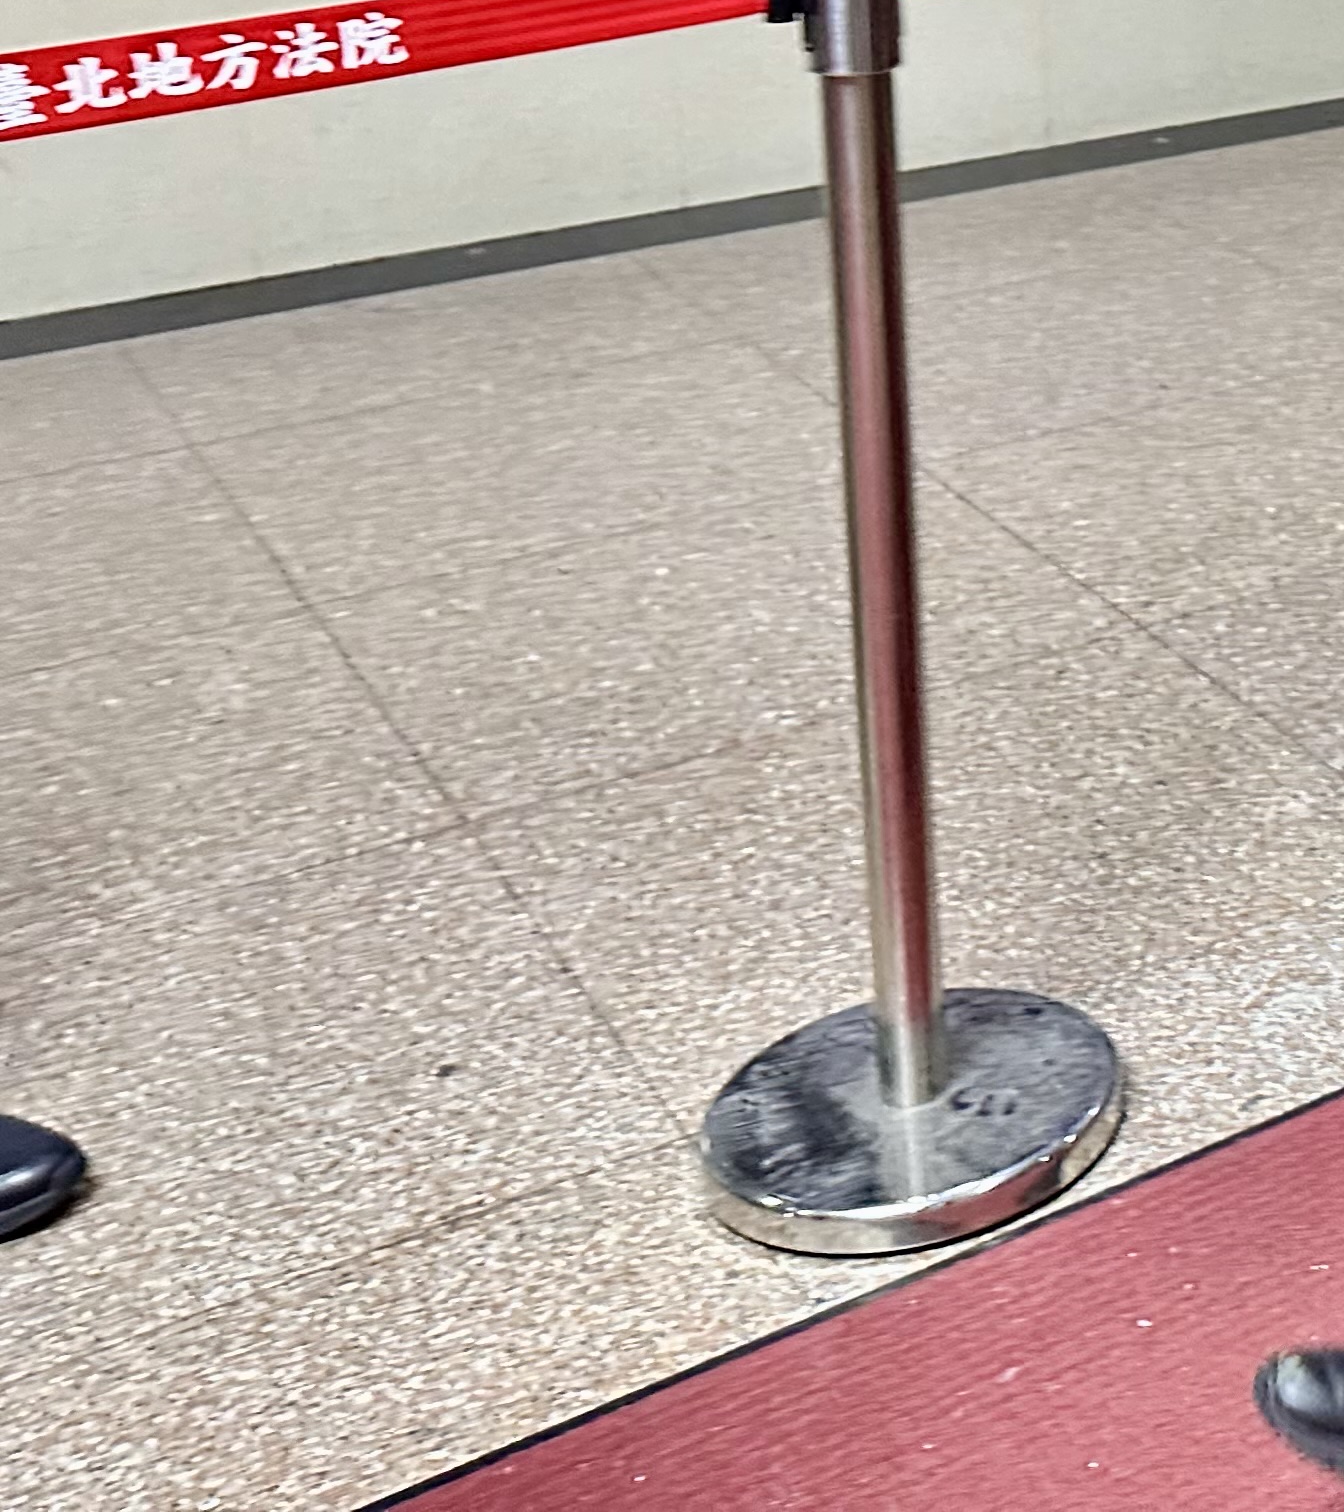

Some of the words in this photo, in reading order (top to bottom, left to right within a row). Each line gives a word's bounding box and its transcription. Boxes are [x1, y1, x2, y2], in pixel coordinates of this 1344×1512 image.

[0, 11, 410, 131] 臺北地方法院
